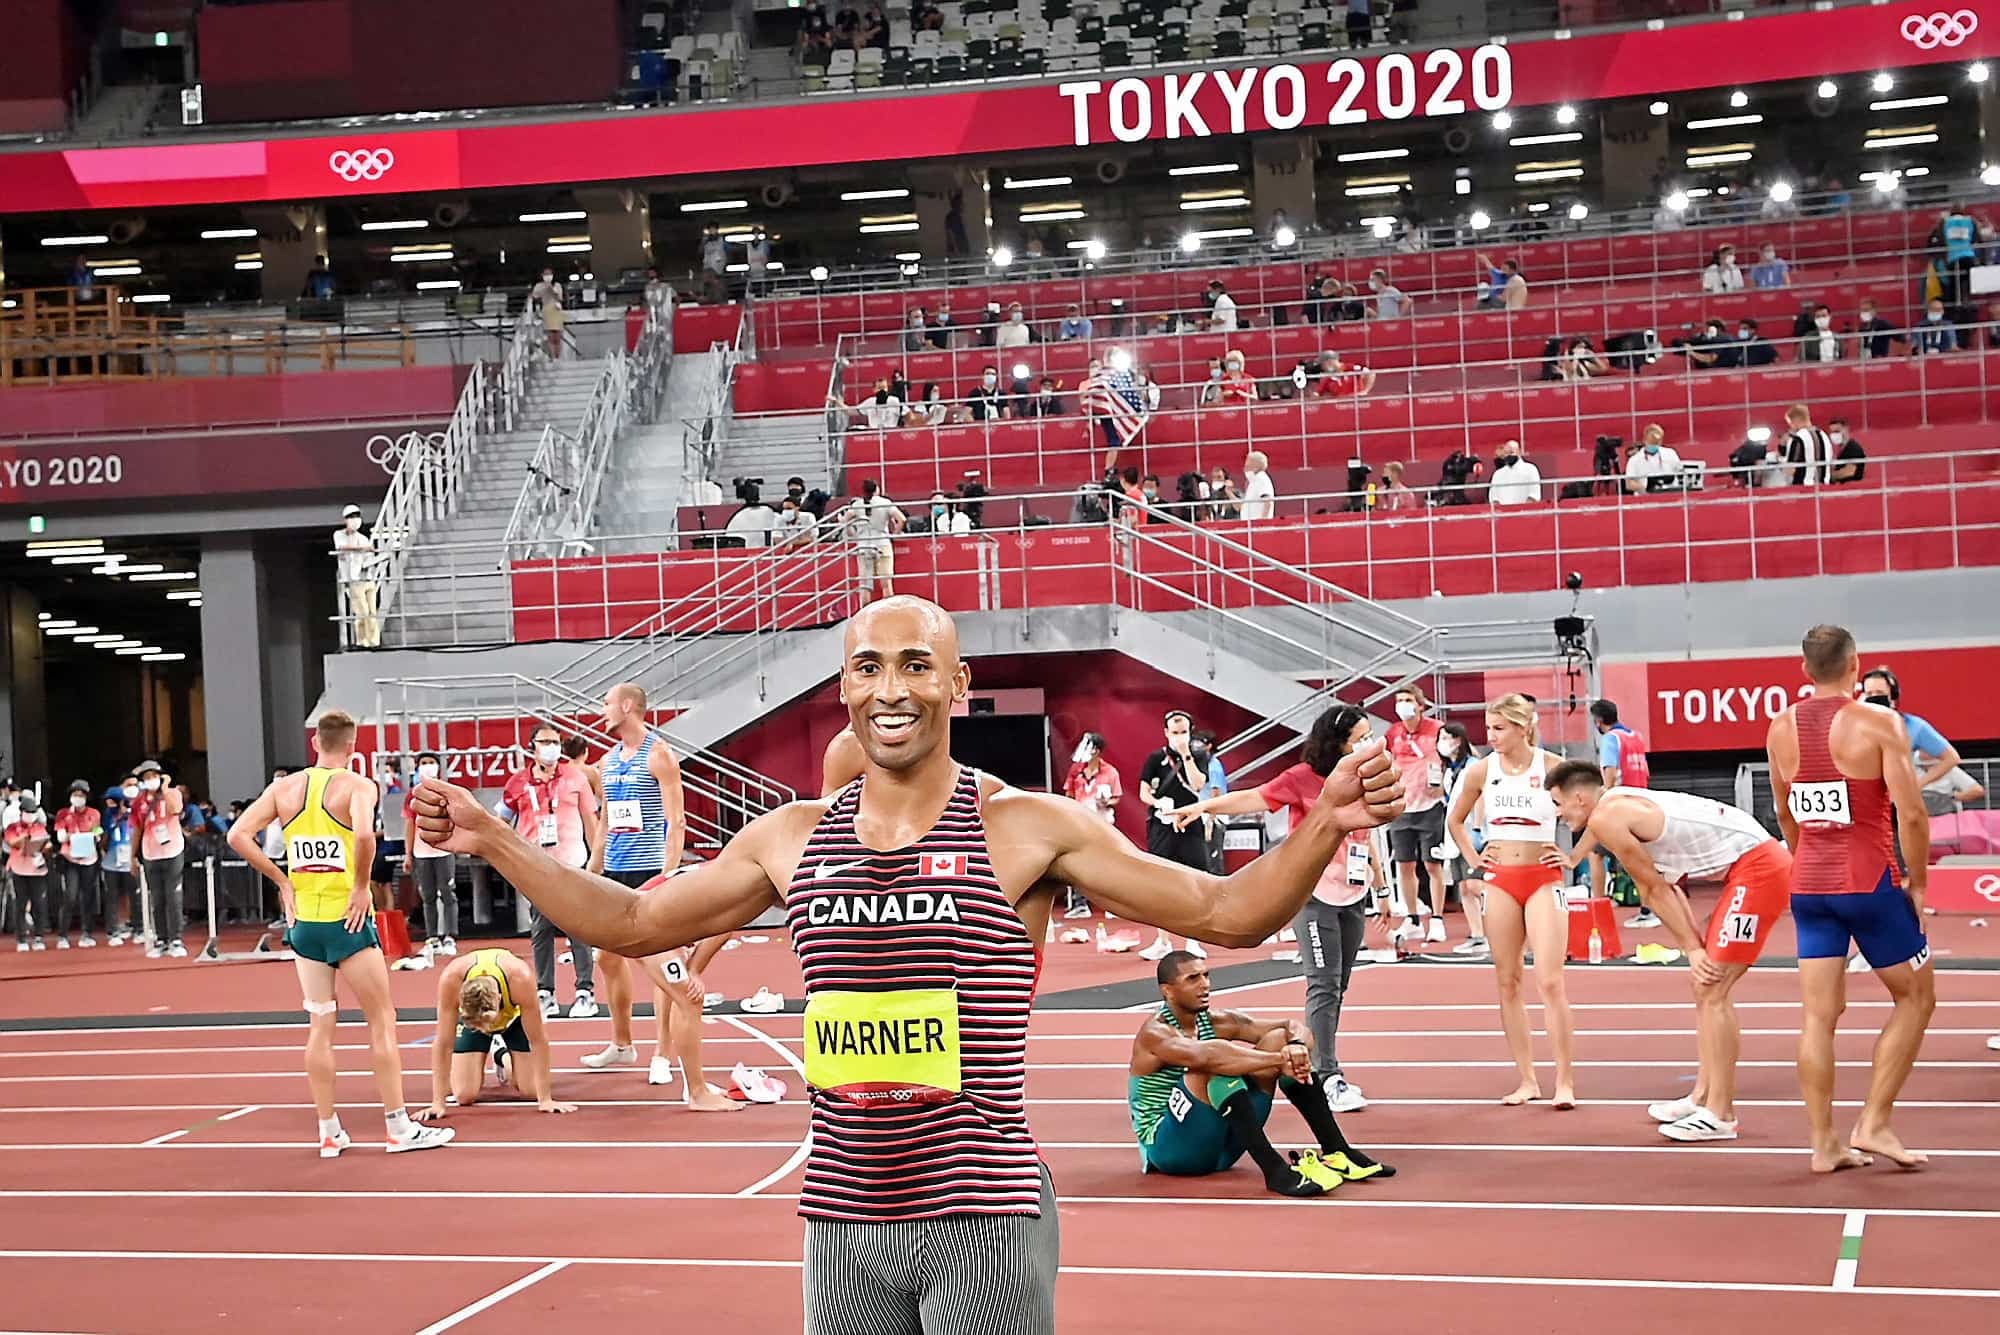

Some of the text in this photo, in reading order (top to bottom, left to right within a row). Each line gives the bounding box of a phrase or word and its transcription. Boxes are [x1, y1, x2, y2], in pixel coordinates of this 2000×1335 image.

[1059, 44, 1513, 147] TOKYO 2020
[0, 455, 122, 488] YO 2020
[1657, 686, 1788, 725] TOKYO
[1791, 789, 1842, 813] 1633
[293, 840, 341, 860] 1082
[808, 893, 960, 925] CANADA
[1734, 916, 1753, 940] 14
[667, 962, 681, 980] 9
[815, 1017, 946, 1056] WARNER
